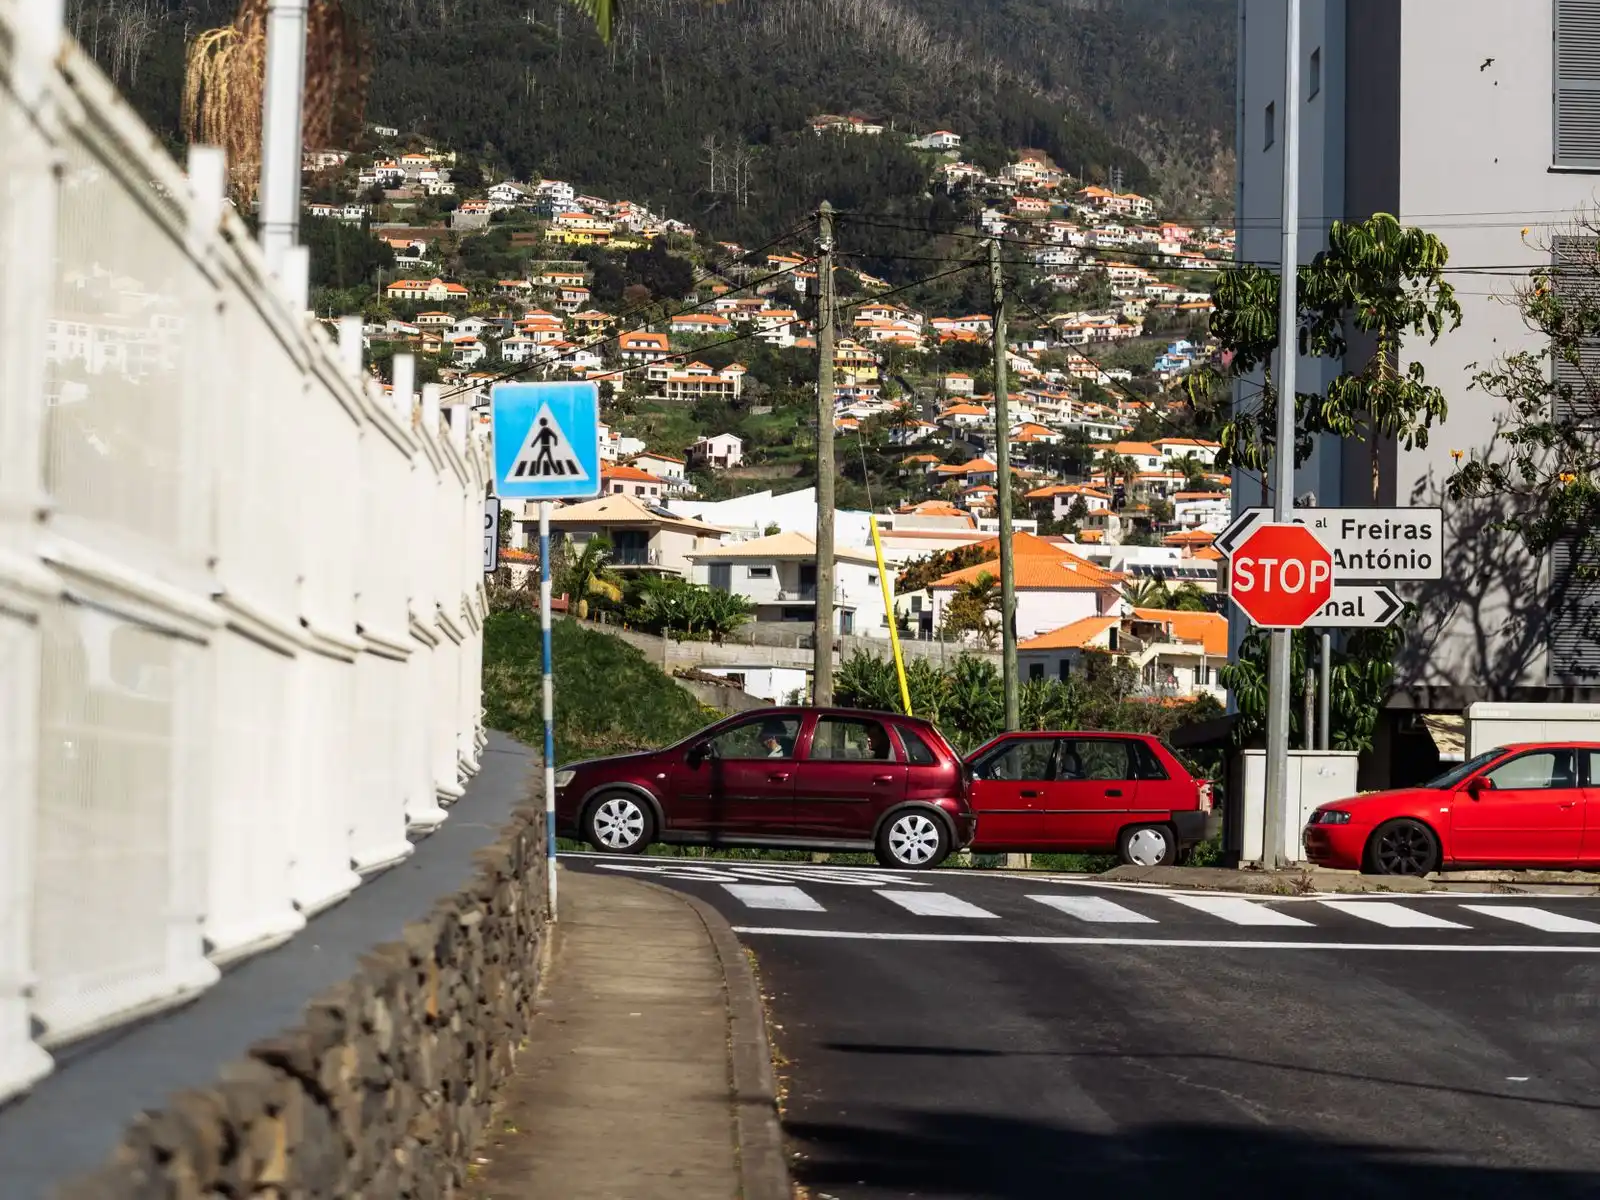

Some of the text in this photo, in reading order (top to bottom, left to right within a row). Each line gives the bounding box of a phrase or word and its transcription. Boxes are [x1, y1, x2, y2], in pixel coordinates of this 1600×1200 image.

[1341, 518, 1432, 540] Freiras
[1334, 548, 1432, 570] António
[1233, 557, 1330, 594] STOP
